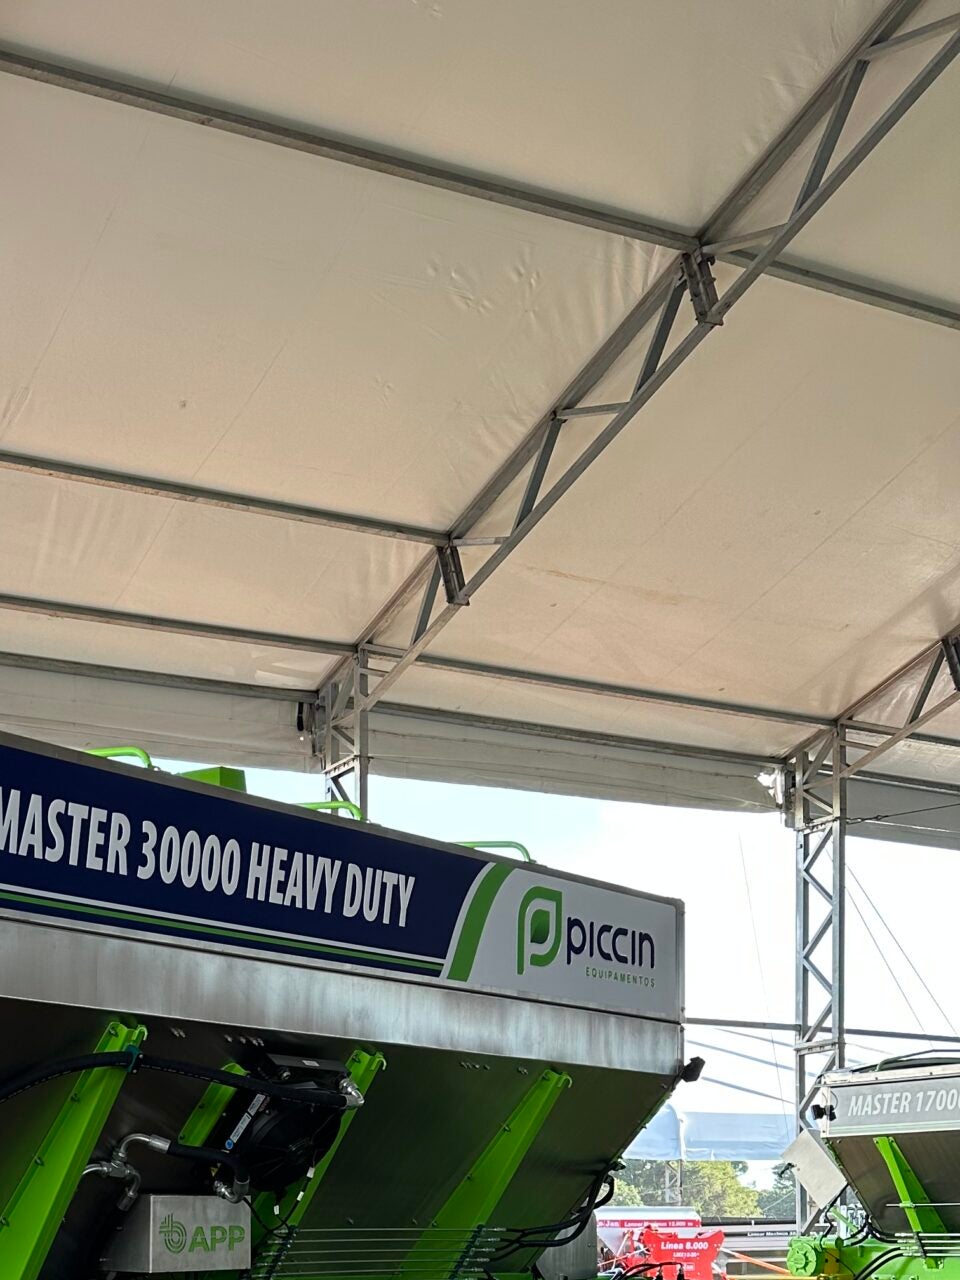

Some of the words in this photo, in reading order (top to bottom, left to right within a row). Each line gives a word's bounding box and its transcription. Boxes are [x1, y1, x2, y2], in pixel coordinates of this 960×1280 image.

[137, 820, 240, 896] 30000
[246, 842, 342, 914] HEAVY
[343, 863, 416, 927] DUTY
[585, 967, 655, 987] EQUIPAMENTOS
[848, 1091, 912, 1117] MASTER
[916, 1088, 960, 1113] 1700
[188, 1225, 246, 1253] APP
[685, 1241, 709, 1250] 8.000
